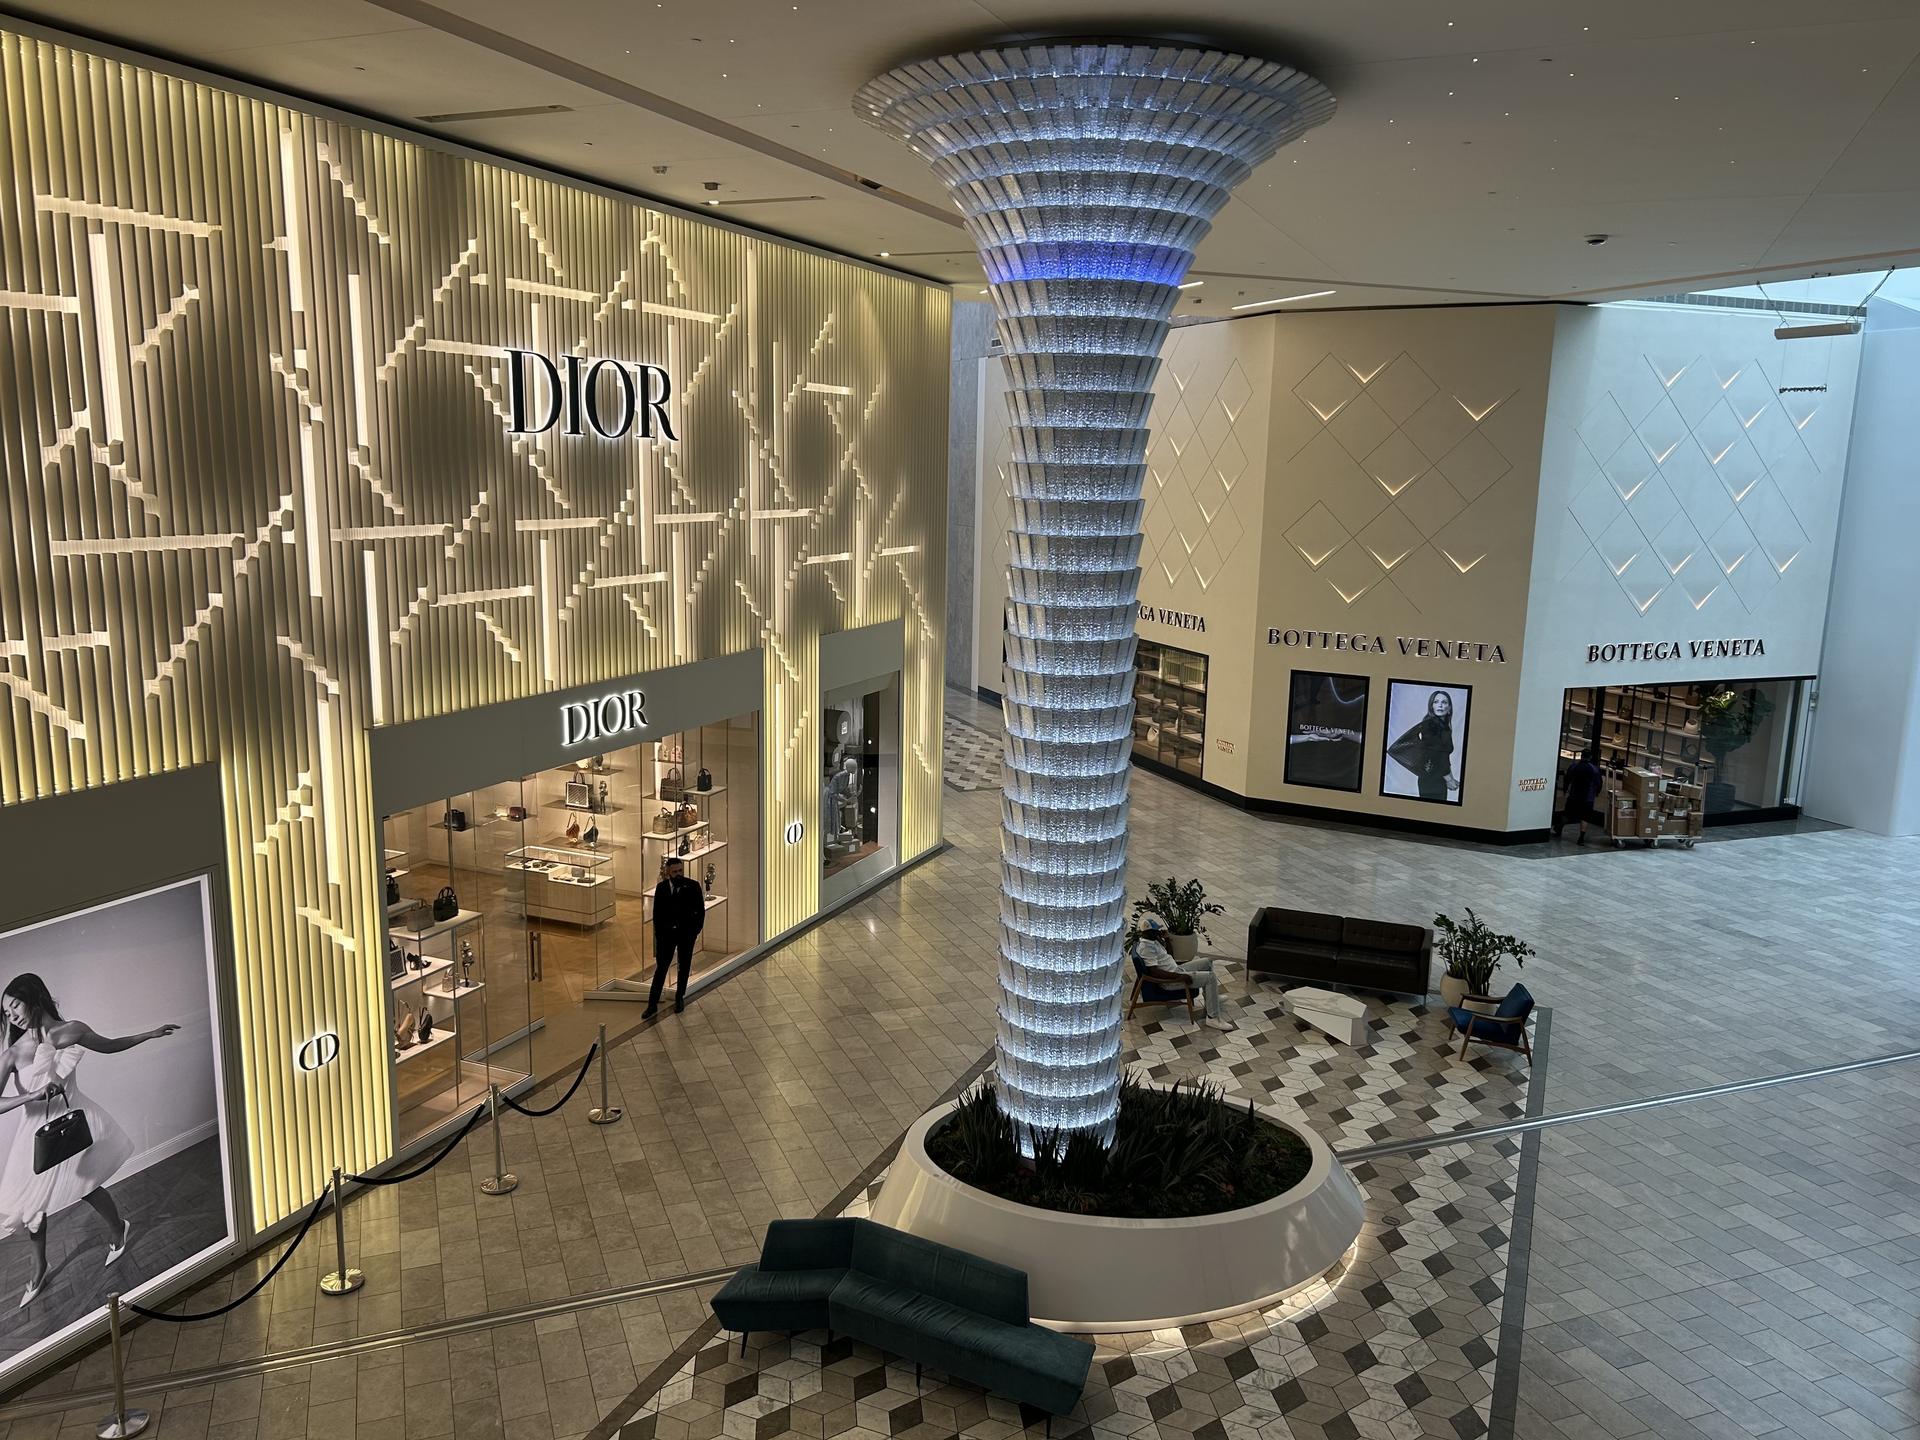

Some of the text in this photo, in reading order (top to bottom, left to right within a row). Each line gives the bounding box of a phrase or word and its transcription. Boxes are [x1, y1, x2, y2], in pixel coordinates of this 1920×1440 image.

[503, 349, 679, 441] DIOR
[1158, 607, 1206, 633] VENETA
[1267, 627, 1507, 664] BOTTEGA VENETA
[1586, 638, 1766, 663] BOTTEGA VENETA
[560, 690, 649, 746] DIOR
[1299, 724, 1355, 736] BOTTEGA VENETA
